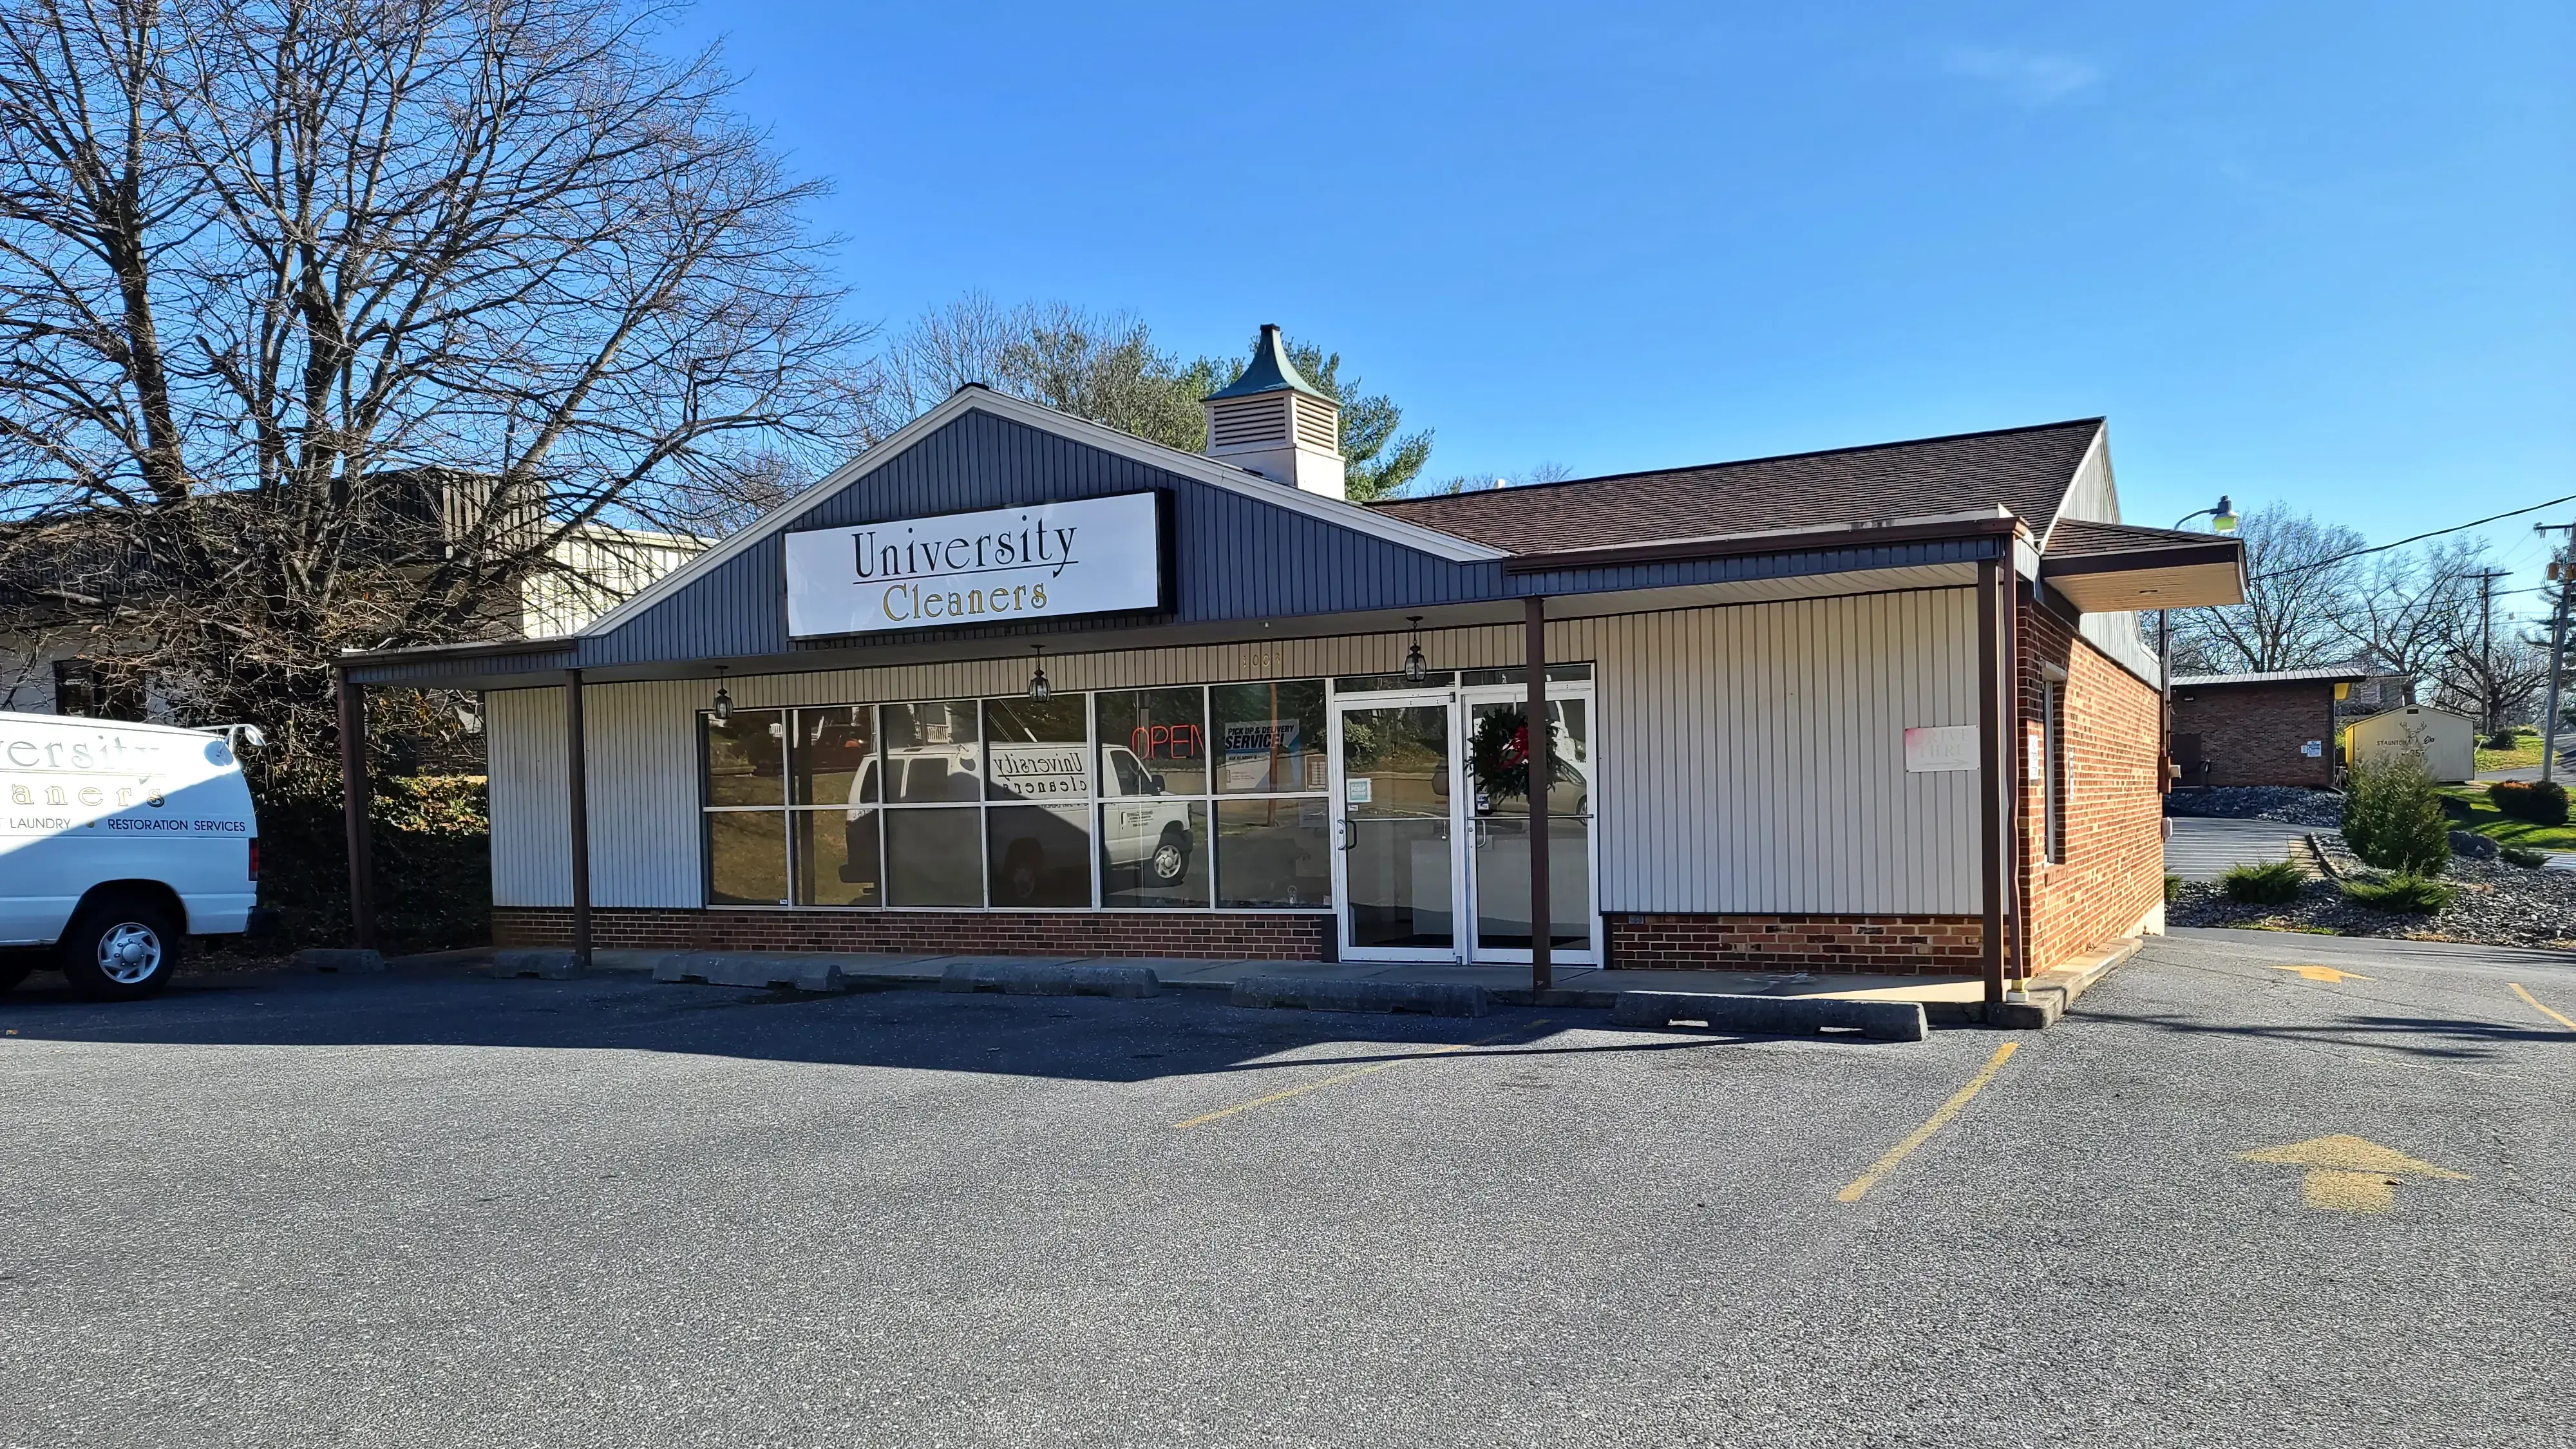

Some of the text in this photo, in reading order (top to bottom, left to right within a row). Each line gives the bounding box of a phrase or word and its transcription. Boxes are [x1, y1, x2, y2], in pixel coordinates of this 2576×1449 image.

[851, 515, 1078, 578] University
[882, 582, 1048, 621] Cleaners
[1228, 727, 1244, 735] PICK
[1262, 724, 1294, 734] DELIVERY
[1915, 729, 1969, 745] RIVE
[1132, 724, 1206, 761] OPEN
[1225, 733, 1285, 750] SERVICE!
[10, 818, 245, 831] LAUNDRY RESTORATION SERVICES
